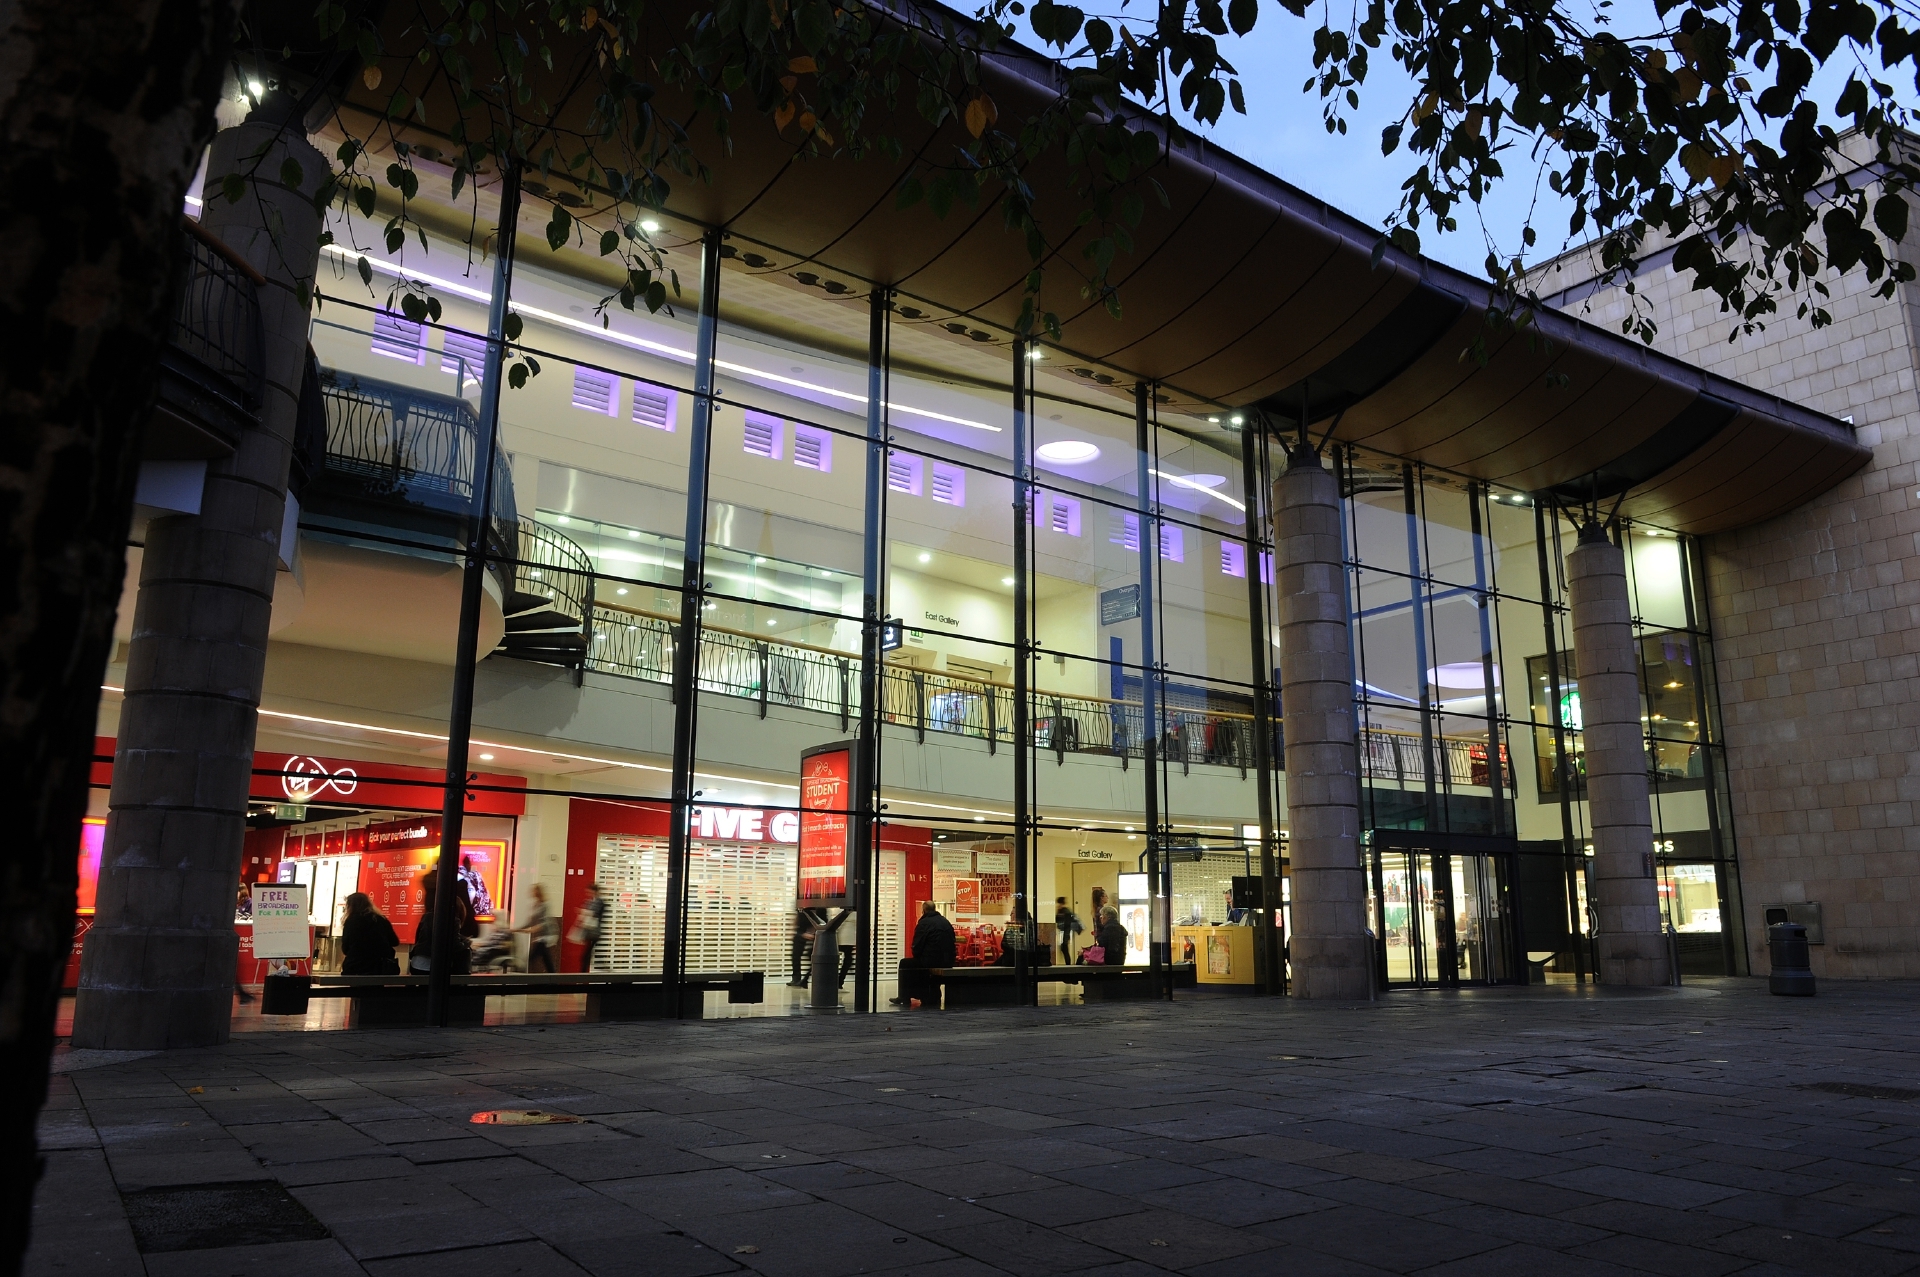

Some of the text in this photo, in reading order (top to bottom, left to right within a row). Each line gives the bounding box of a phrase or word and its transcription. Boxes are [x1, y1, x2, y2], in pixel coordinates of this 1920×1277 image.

[925, 611, 960, 627] East Gallery
[806, 782, 840, 799] STUDENT
[685, 805, 764, 840] FIVE
[380, 832, 391, 844] your
[391, 829, 409, 843] perfect
[409, 826, 428, 838] bundle
[1078, 849, 1113, 860] East Gallery
[261, 891, 288, 902] FREE
[957, 887, 971, 895] STOP
[257, 902, 300, 910] BROADBAND
